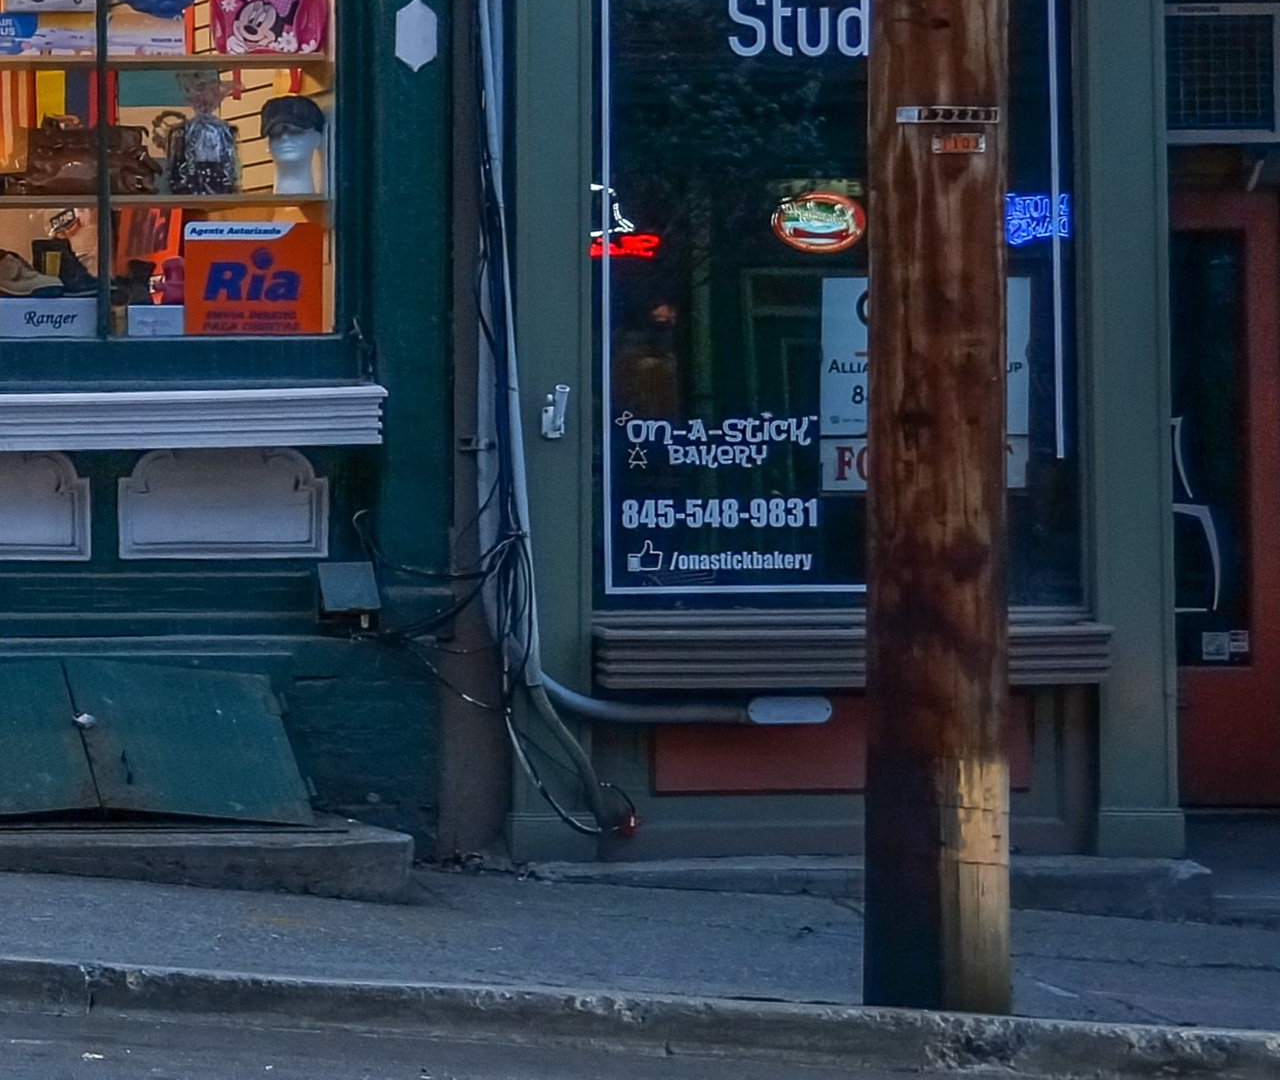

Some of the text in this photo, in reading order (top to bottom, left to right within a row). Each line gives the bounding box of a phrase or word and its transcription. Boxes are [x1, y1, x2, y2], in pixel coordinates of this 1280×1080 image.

[190, 226, 282, 236] Agente Autorizado
[202, 247, 302, 302] Ria
[24, 310, 79, 330] Ranger
[622, 498, 818, 529] 845-548-9831
[669, 550, 813, 571] /onastickbakery
